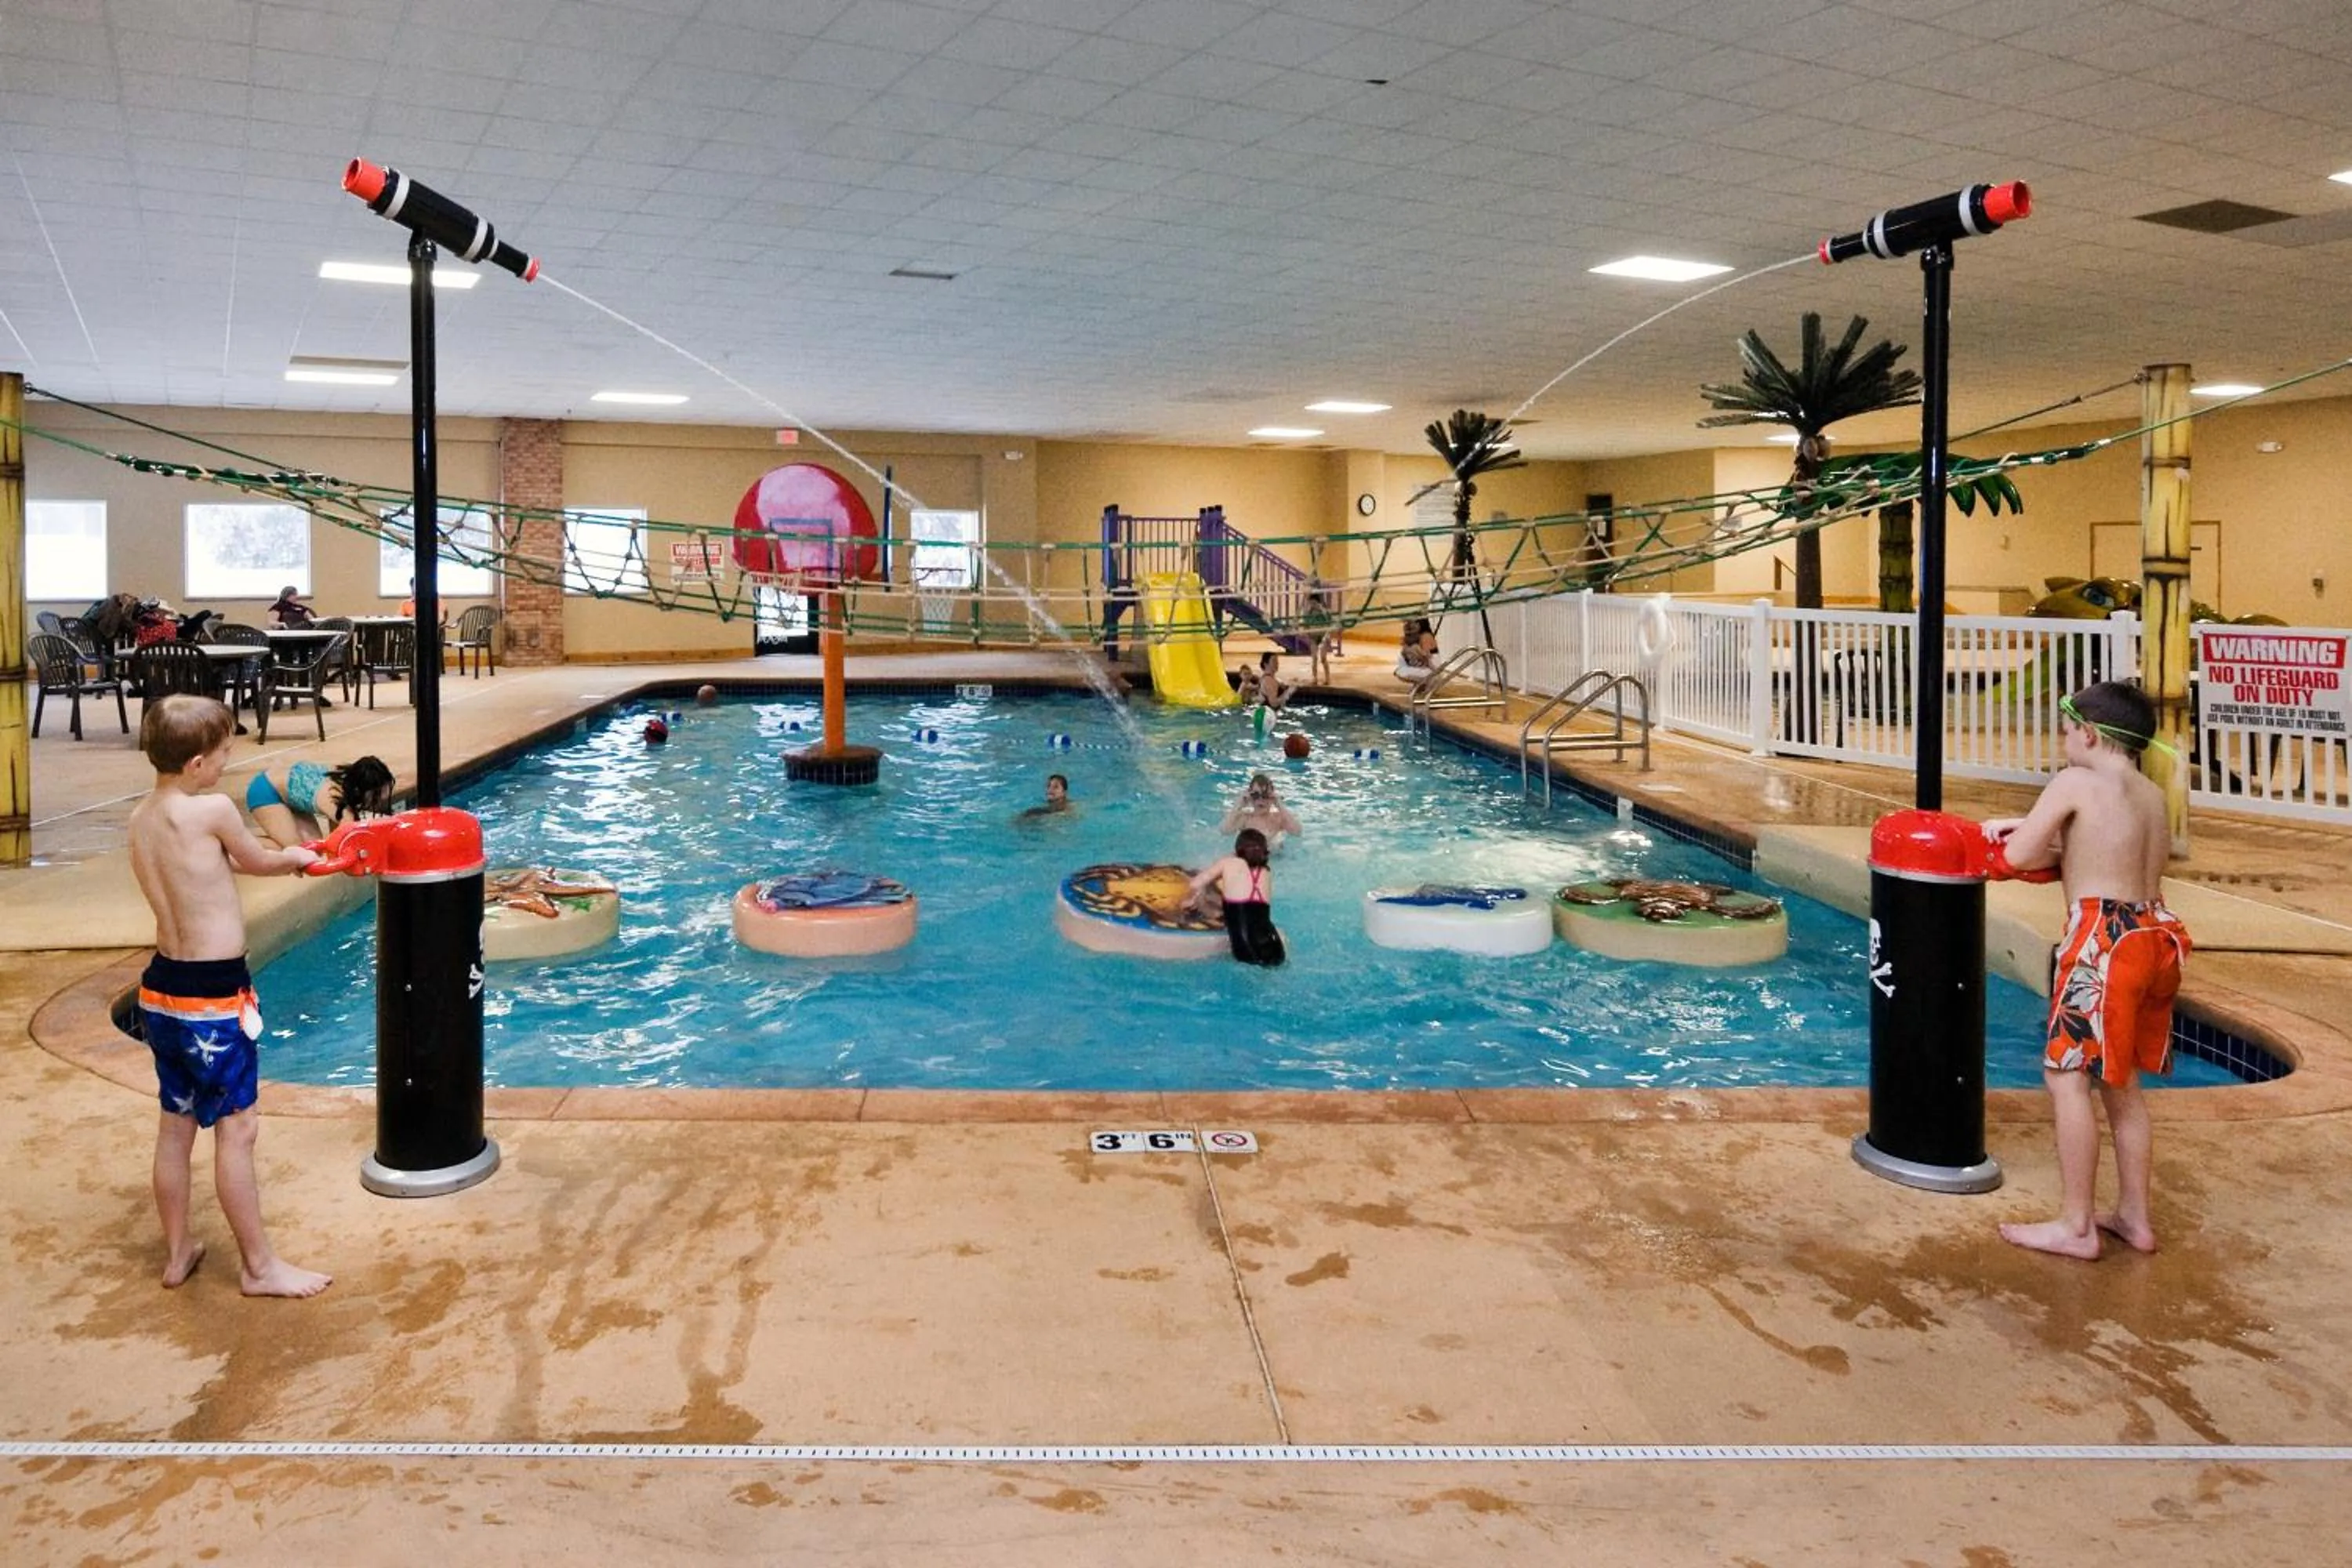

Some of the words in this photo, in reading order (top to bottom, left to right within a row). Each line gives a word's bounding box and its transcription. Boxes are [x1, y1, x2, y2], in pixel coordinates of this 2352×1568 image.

[2209, 636, 2338, 664] WARNING
[2209, 666, 2234, 683] NO
[2241, 667, 2339, 689] LIFEGUARD
[2234, 684, 2259, 702] ON
[2267, 687, 2314, 706] DUTY
[1097, 1134, 1122, 1149] 3
[1149, 1133, 1175, 1149] 6
